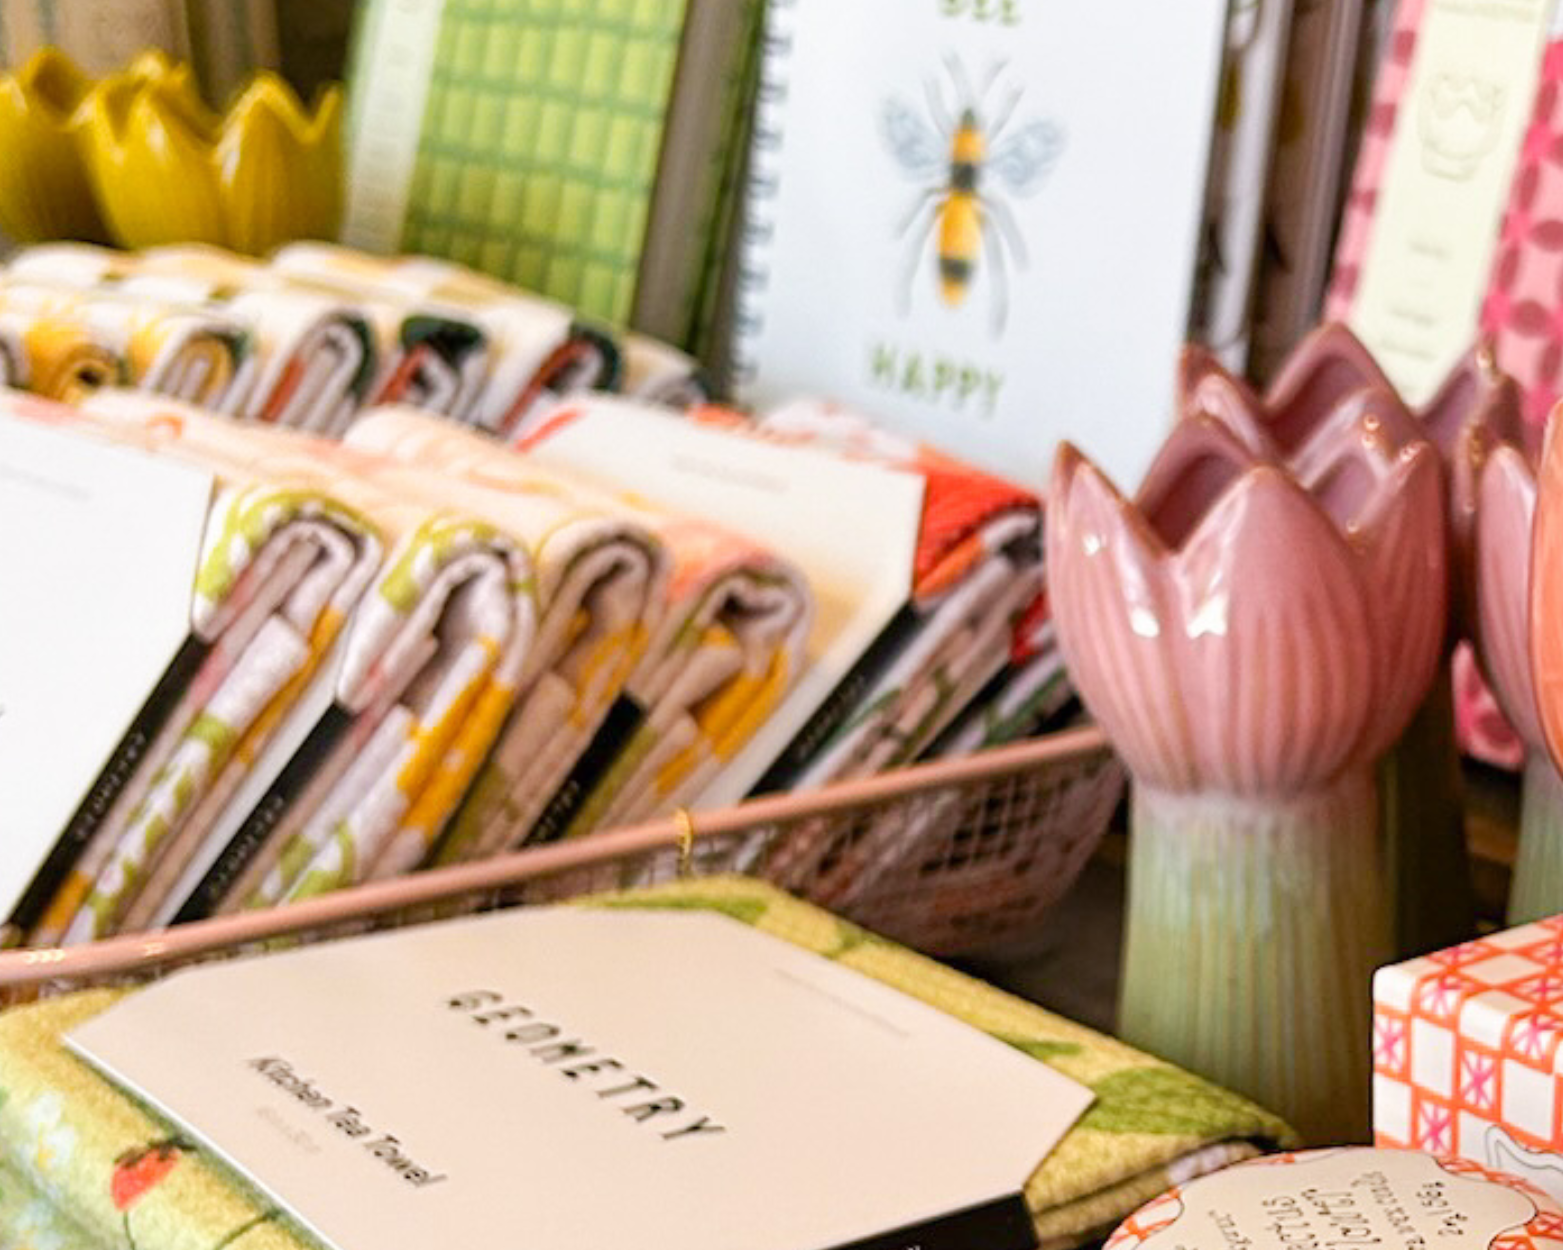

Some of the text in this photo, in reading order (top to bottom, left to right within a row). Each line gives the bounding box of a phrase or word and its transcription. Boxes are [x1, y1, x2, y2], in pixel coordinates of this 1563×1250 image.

[866, 341, 1008, 420] HAPPY
[247, 1054, 334, 1112] Kitchen
[326, 1105, 372, 1140] Tea
[364, 1132, 449, 1190] Towel
[446, 989, 726, 1142] GEOMETRY
